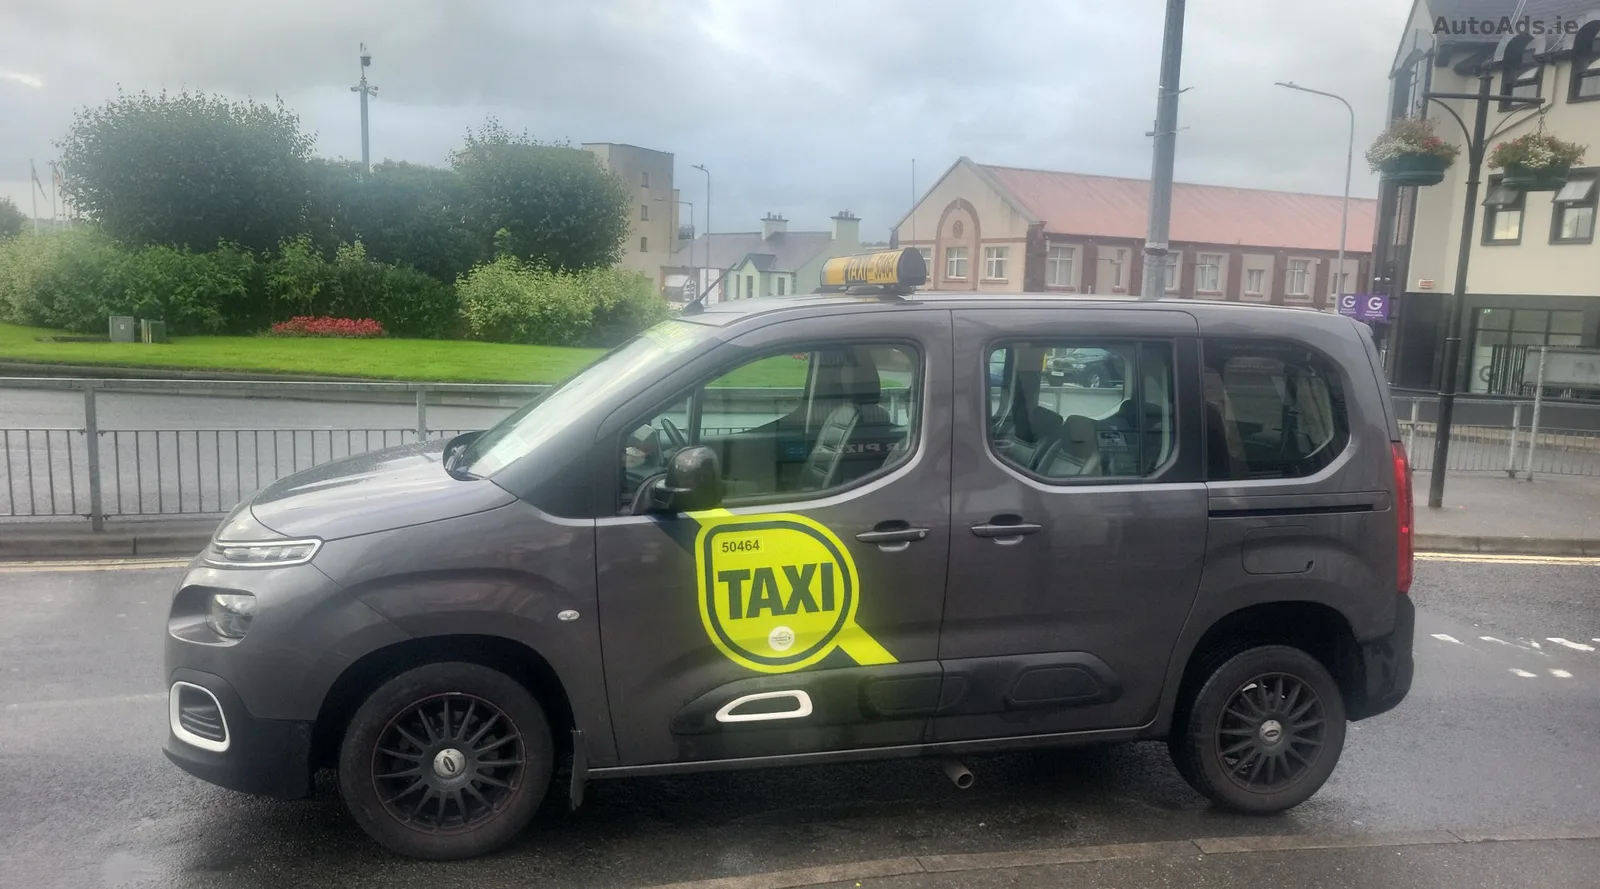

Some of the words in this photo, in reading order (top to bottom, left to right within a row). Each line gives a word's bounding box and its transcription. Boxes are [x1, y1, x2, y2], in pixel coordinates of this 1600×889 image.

[846, 255, 868, 281] TAXI
[1342, 295, 1356, 308] G
[1367, 297, 1383, 310] G
[721, 540, 760, 553] 50464
[717, 562, 835, 620] TAXI
